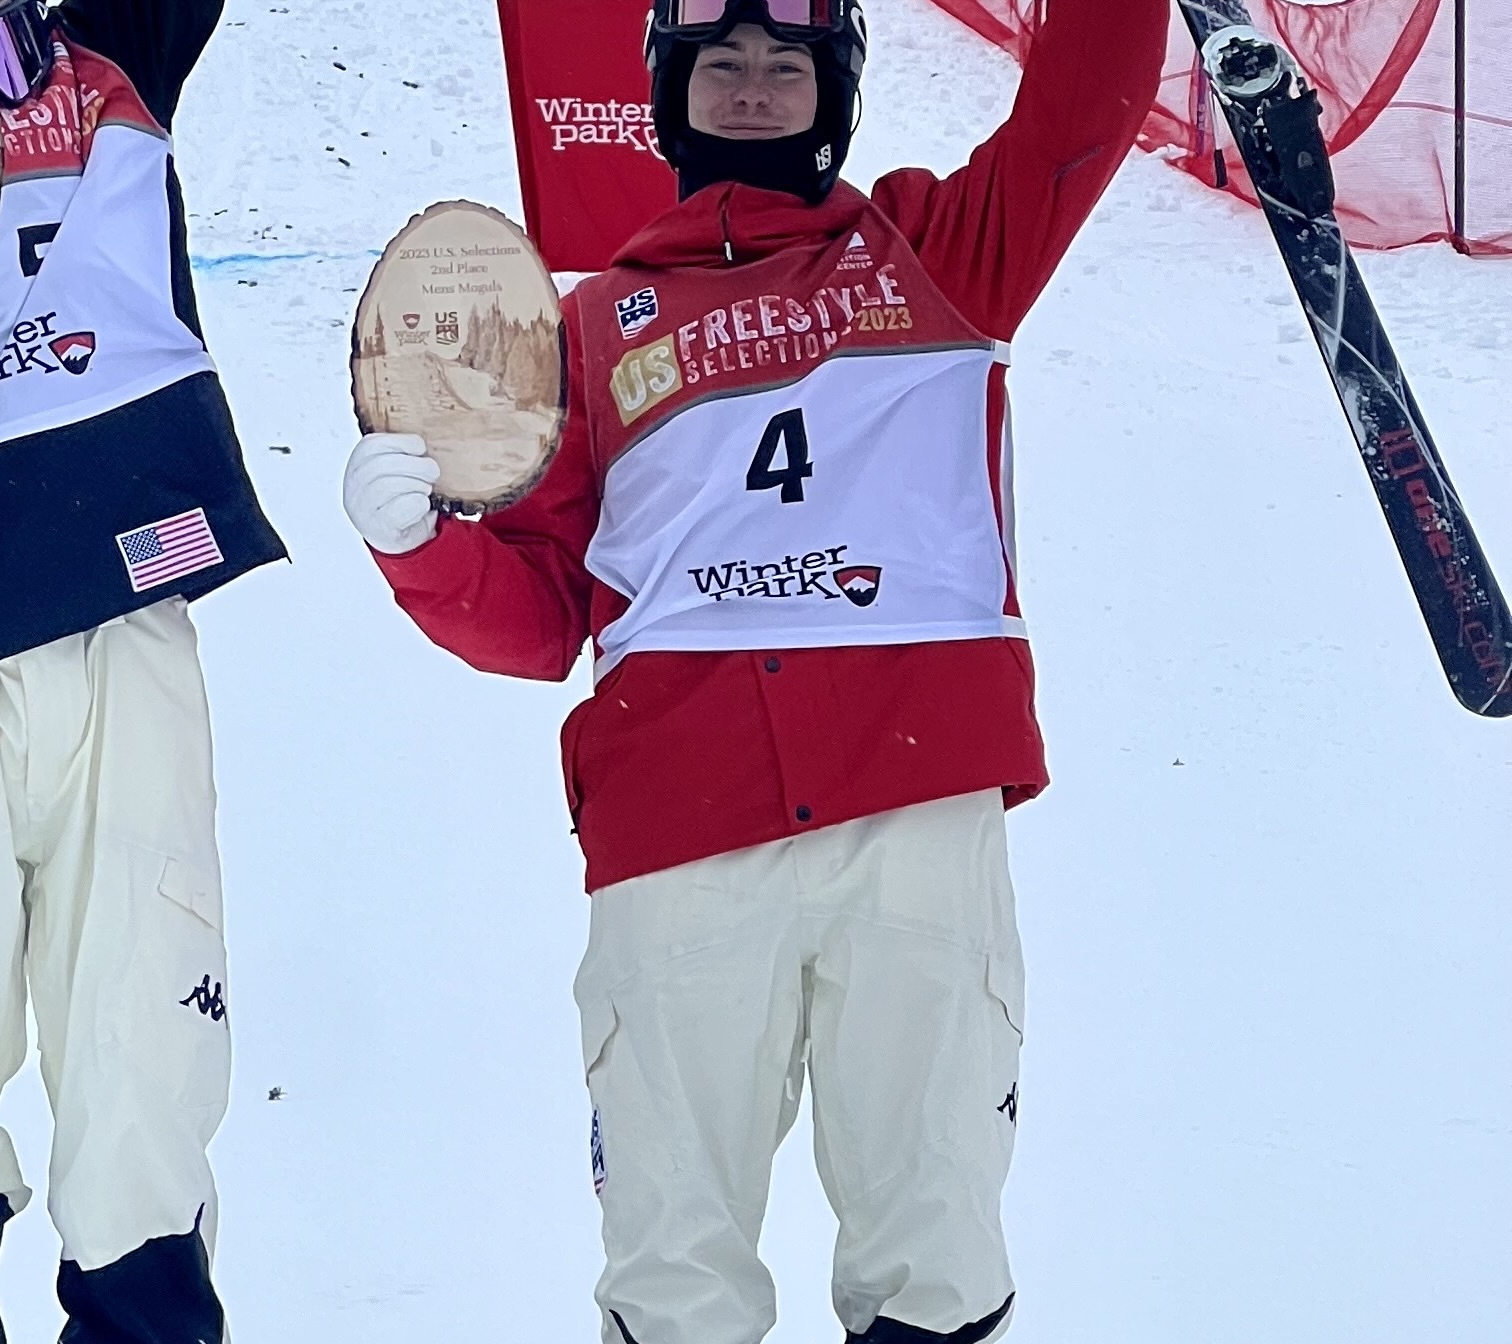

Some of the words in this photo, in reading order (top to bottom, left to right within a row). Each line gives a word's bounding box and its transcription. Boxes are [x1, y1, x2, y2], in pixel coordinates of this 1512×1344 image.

[535, 98, 655, 122] Winter
[399, 248, 430, 260] 2023
[460, 244, 522, 257] Selections
[430, 262, 454, 275] 2nd
[457, 262, 489, 274] Place
[422, 284, 455, 295] Mens
[458, 280, 503, 296] Moguls
[617, 289, 655, 313] US
[435, 311, 458, 324] US
[854, 306, 914, 332] 2023
[612, 344, 676, 412] US
[677, 263, 907, 362] FREESTYLE
[745, 407, 815, 504] 4
[688, 544, 848, 594] Winter
